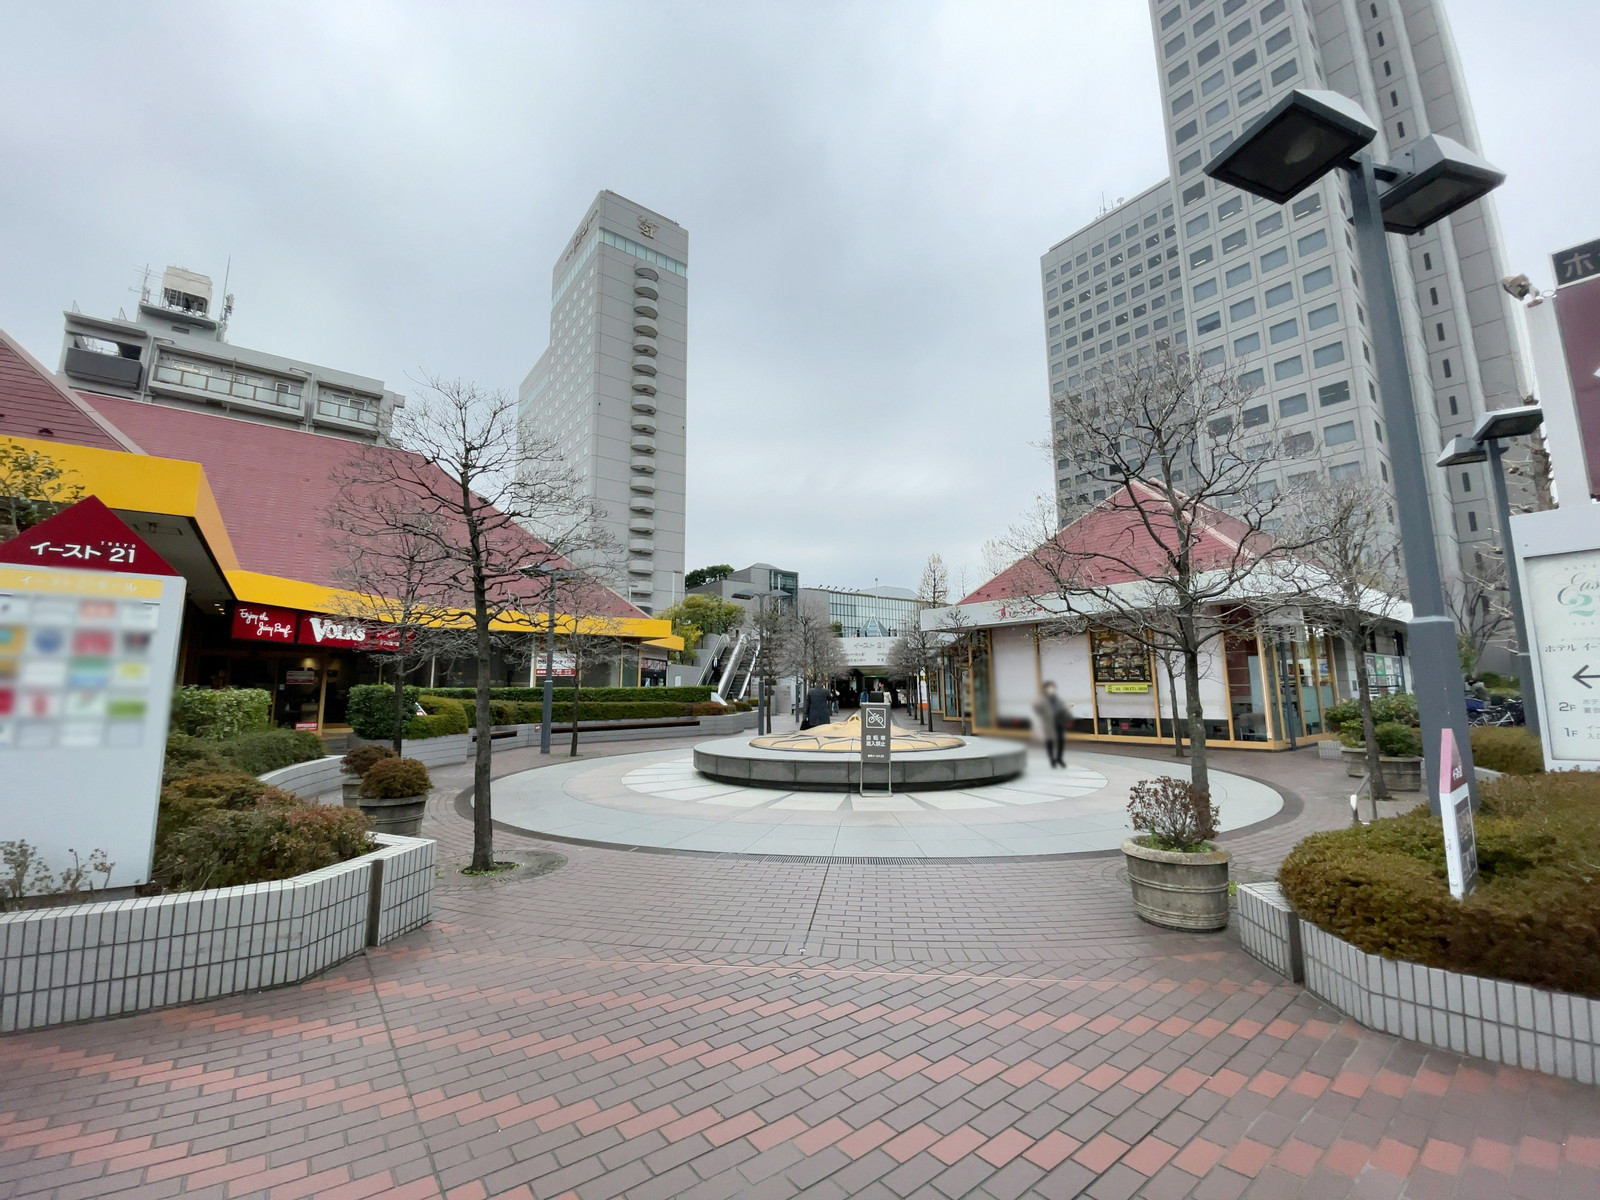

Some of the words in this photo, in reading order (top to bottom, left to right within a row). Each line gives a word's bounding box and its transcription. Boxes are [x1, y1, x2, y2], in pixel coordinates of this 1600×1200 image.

[1562, 252, 1600, 278] ホ
[101, 541, 136, 549] TOKYO
[30, 541, 102, 560] イースト
[109, 547, 136, 564] 21
[259, 612, 269, 621] the
[274, 622, 292, 638] Beef
[310, 617, 366, 643] VOLKS
[1545, 643, 1577, 653] ホテル
[1583, 643, 1600, 651] イー
[1559, 701, 1576, 712] 2F
[1564, 727, 1579, 738] 1F
